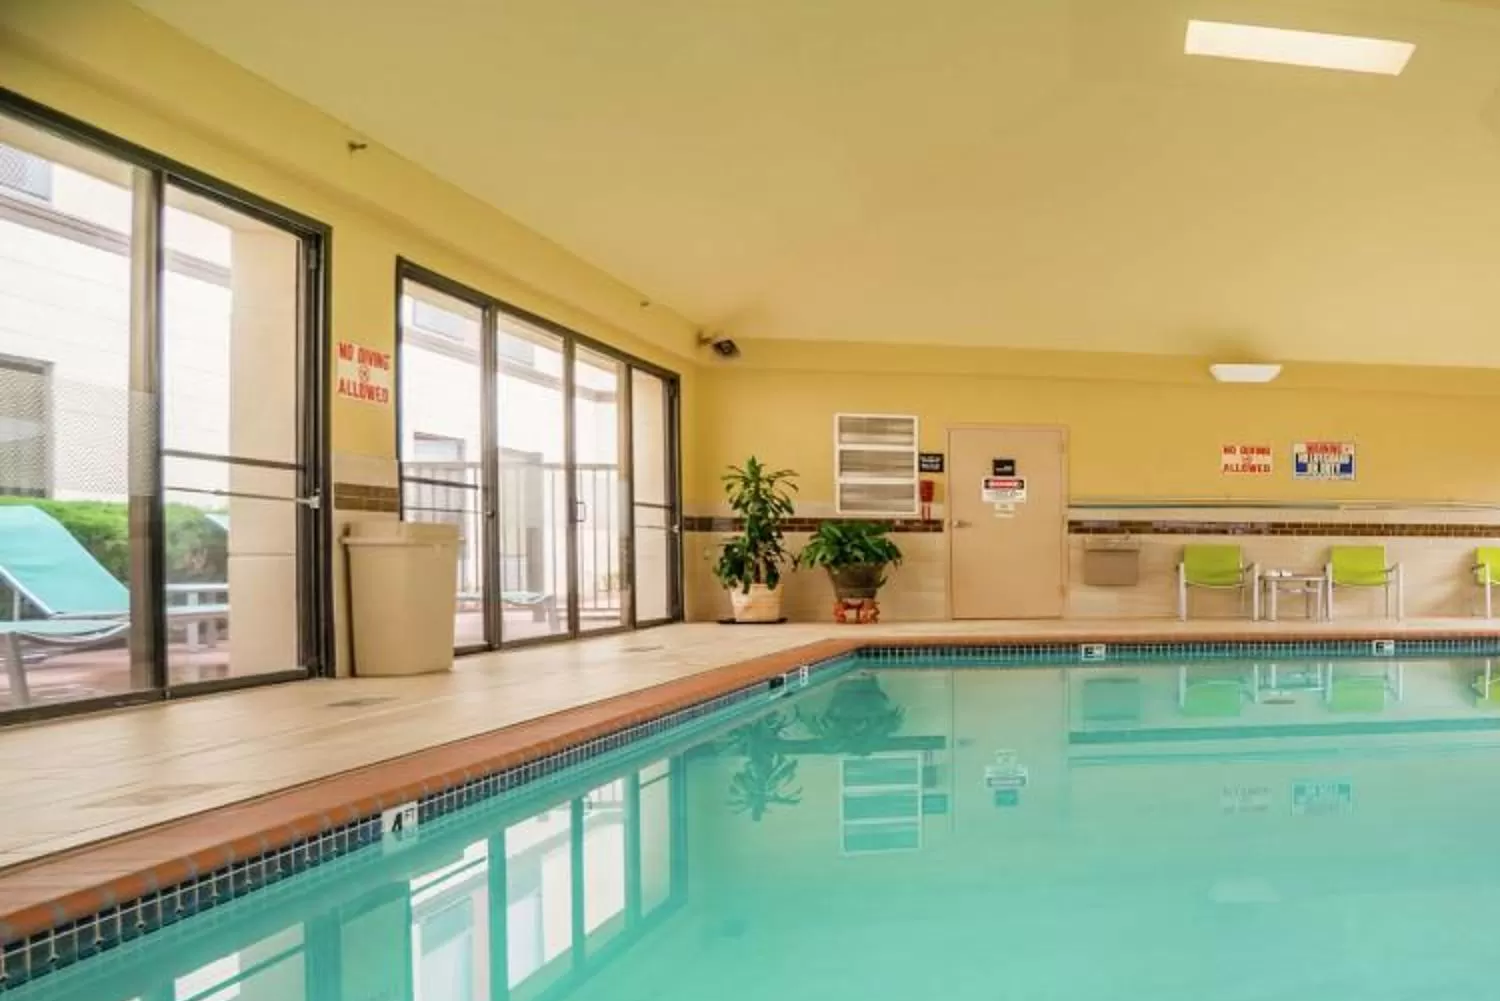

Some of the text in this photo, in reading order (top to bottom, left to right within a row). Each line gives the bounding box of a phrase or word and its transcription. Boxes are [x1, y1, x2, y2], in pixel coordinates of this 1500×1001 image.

[339, 342, 391, 370] NO DIVING
[338, 377, 389, 404] ALLOWED
[1223, 446, 1237, 455] NO
[1223, 464, 1271, 473] ALLOWED
